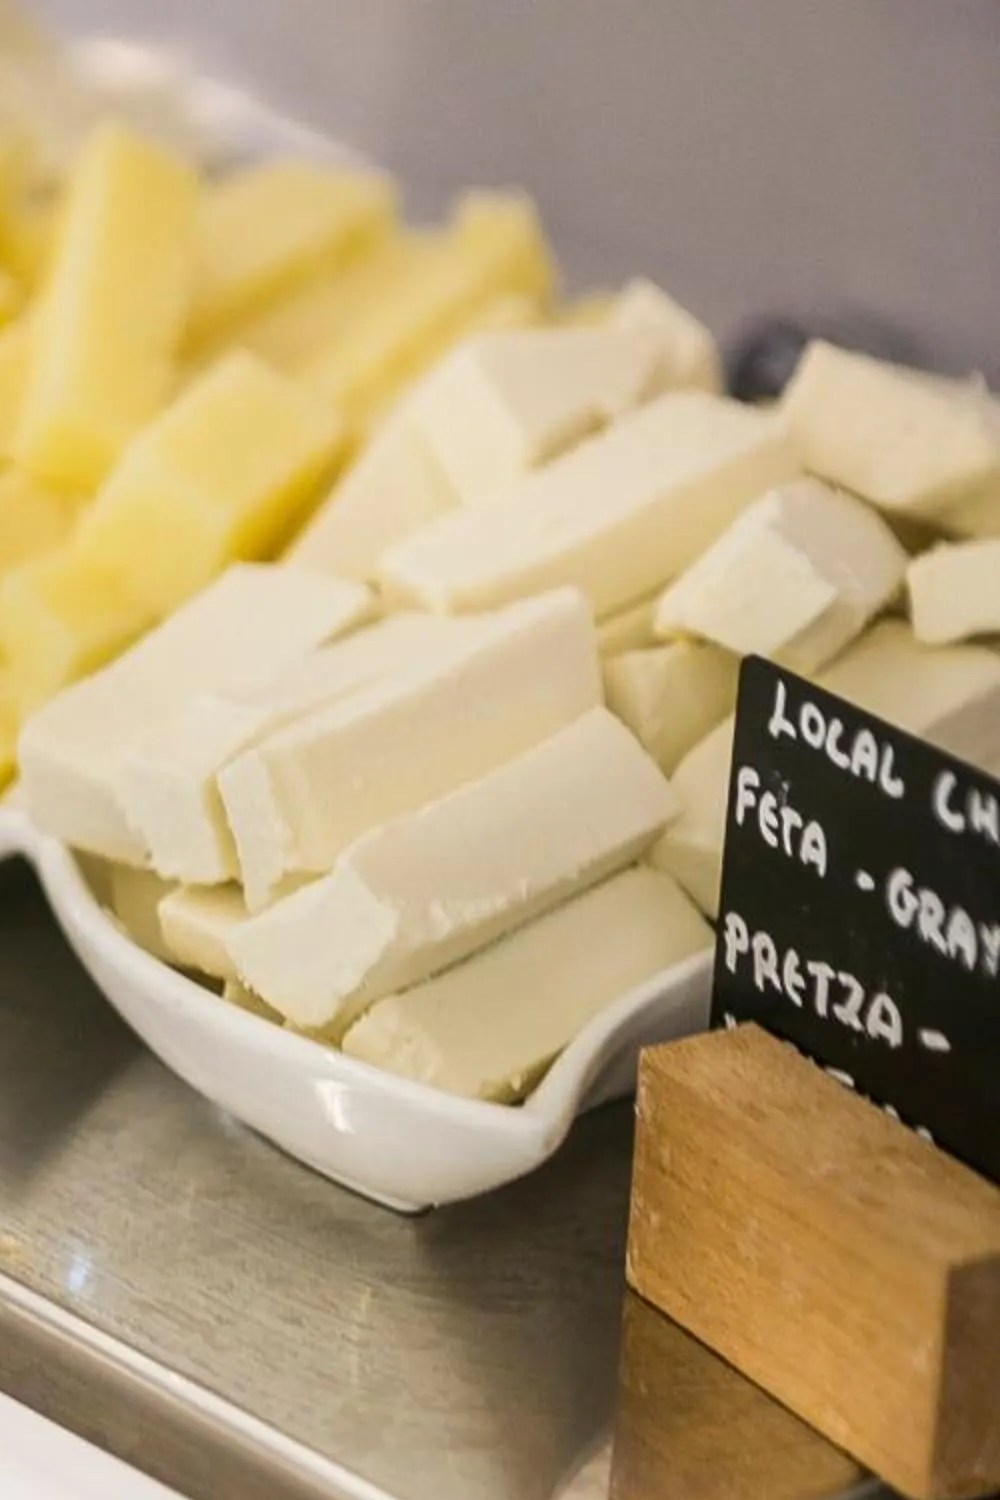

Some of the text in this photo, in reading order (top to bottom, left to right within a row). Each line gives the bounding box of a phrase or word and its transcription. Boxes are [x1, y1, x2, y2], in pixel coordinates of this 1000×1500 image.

[767, 679, 904, 800] LOCAL
[735, 765, 827, 878] FETA
[723, 911, 903, 1049] PRETZA
